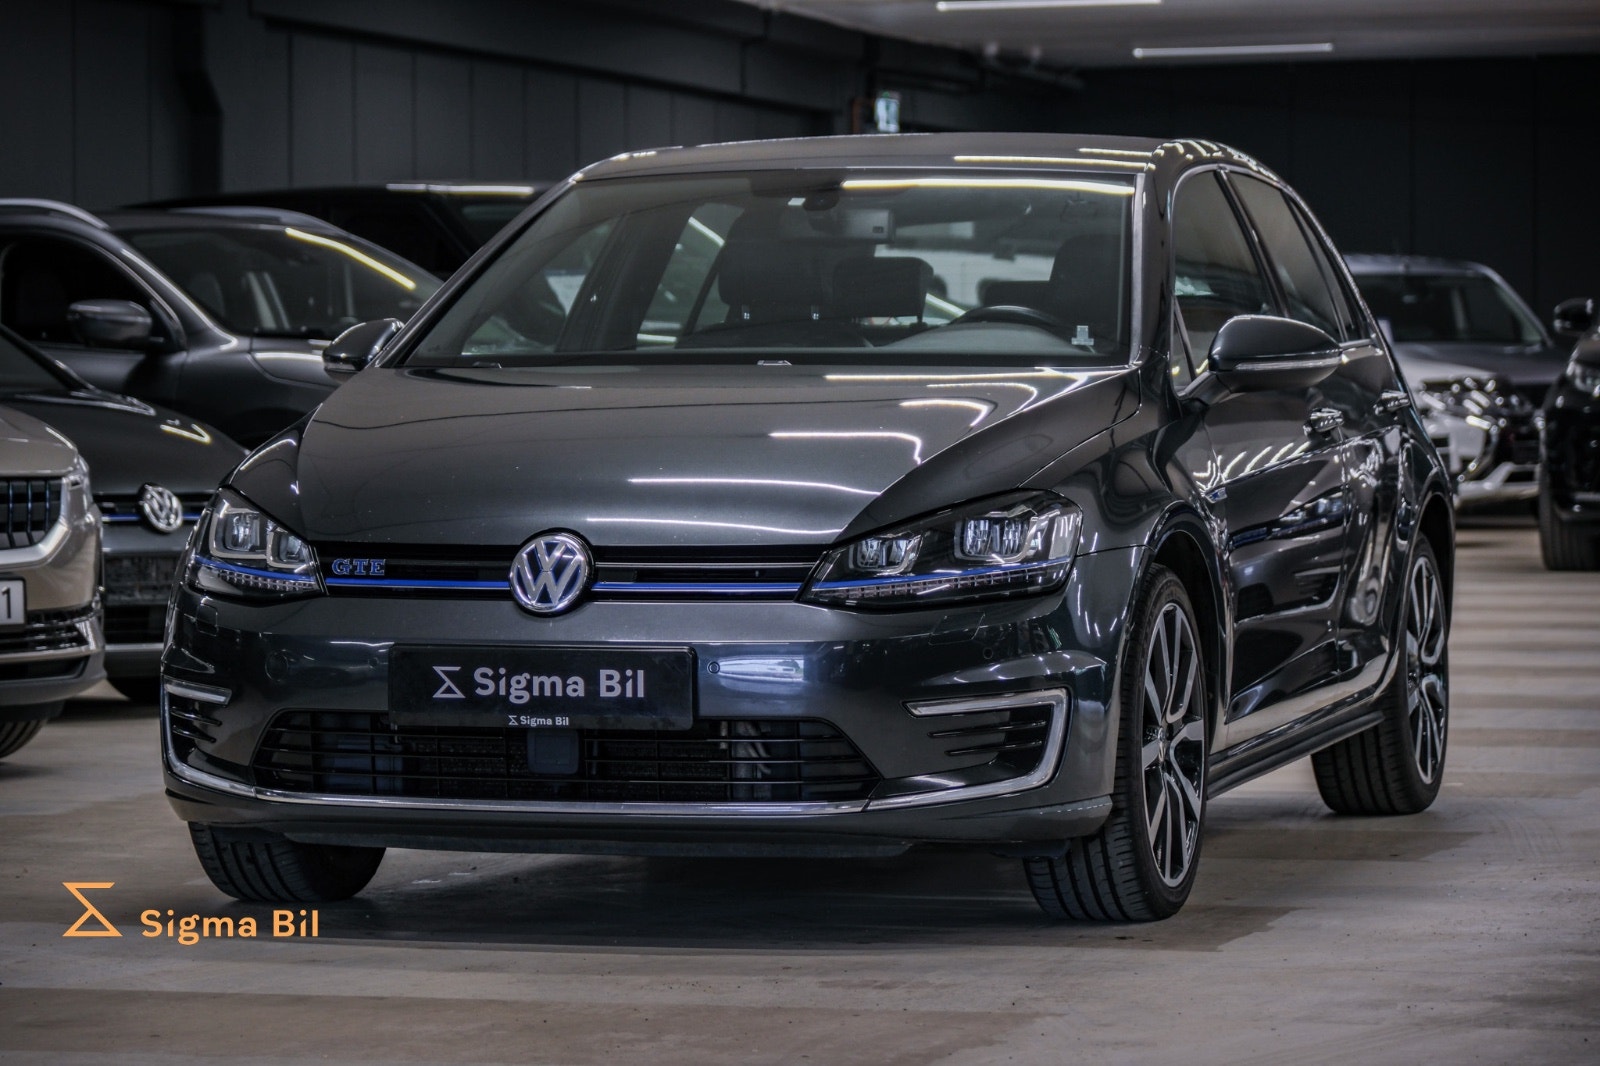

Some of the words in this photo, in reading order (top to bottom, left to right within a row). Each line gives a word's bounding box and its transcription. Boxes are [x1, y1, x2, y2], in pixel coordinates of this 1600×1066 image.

[332, 558, 386, 576] GTE
[511, 535, 588, 611] VW
[473, 667, 585, 704] Sigma
[600, 669, 645, 698] Bil
[520, 716, 552, 727] Sigma
[555, 716, 569, 726] Bil
